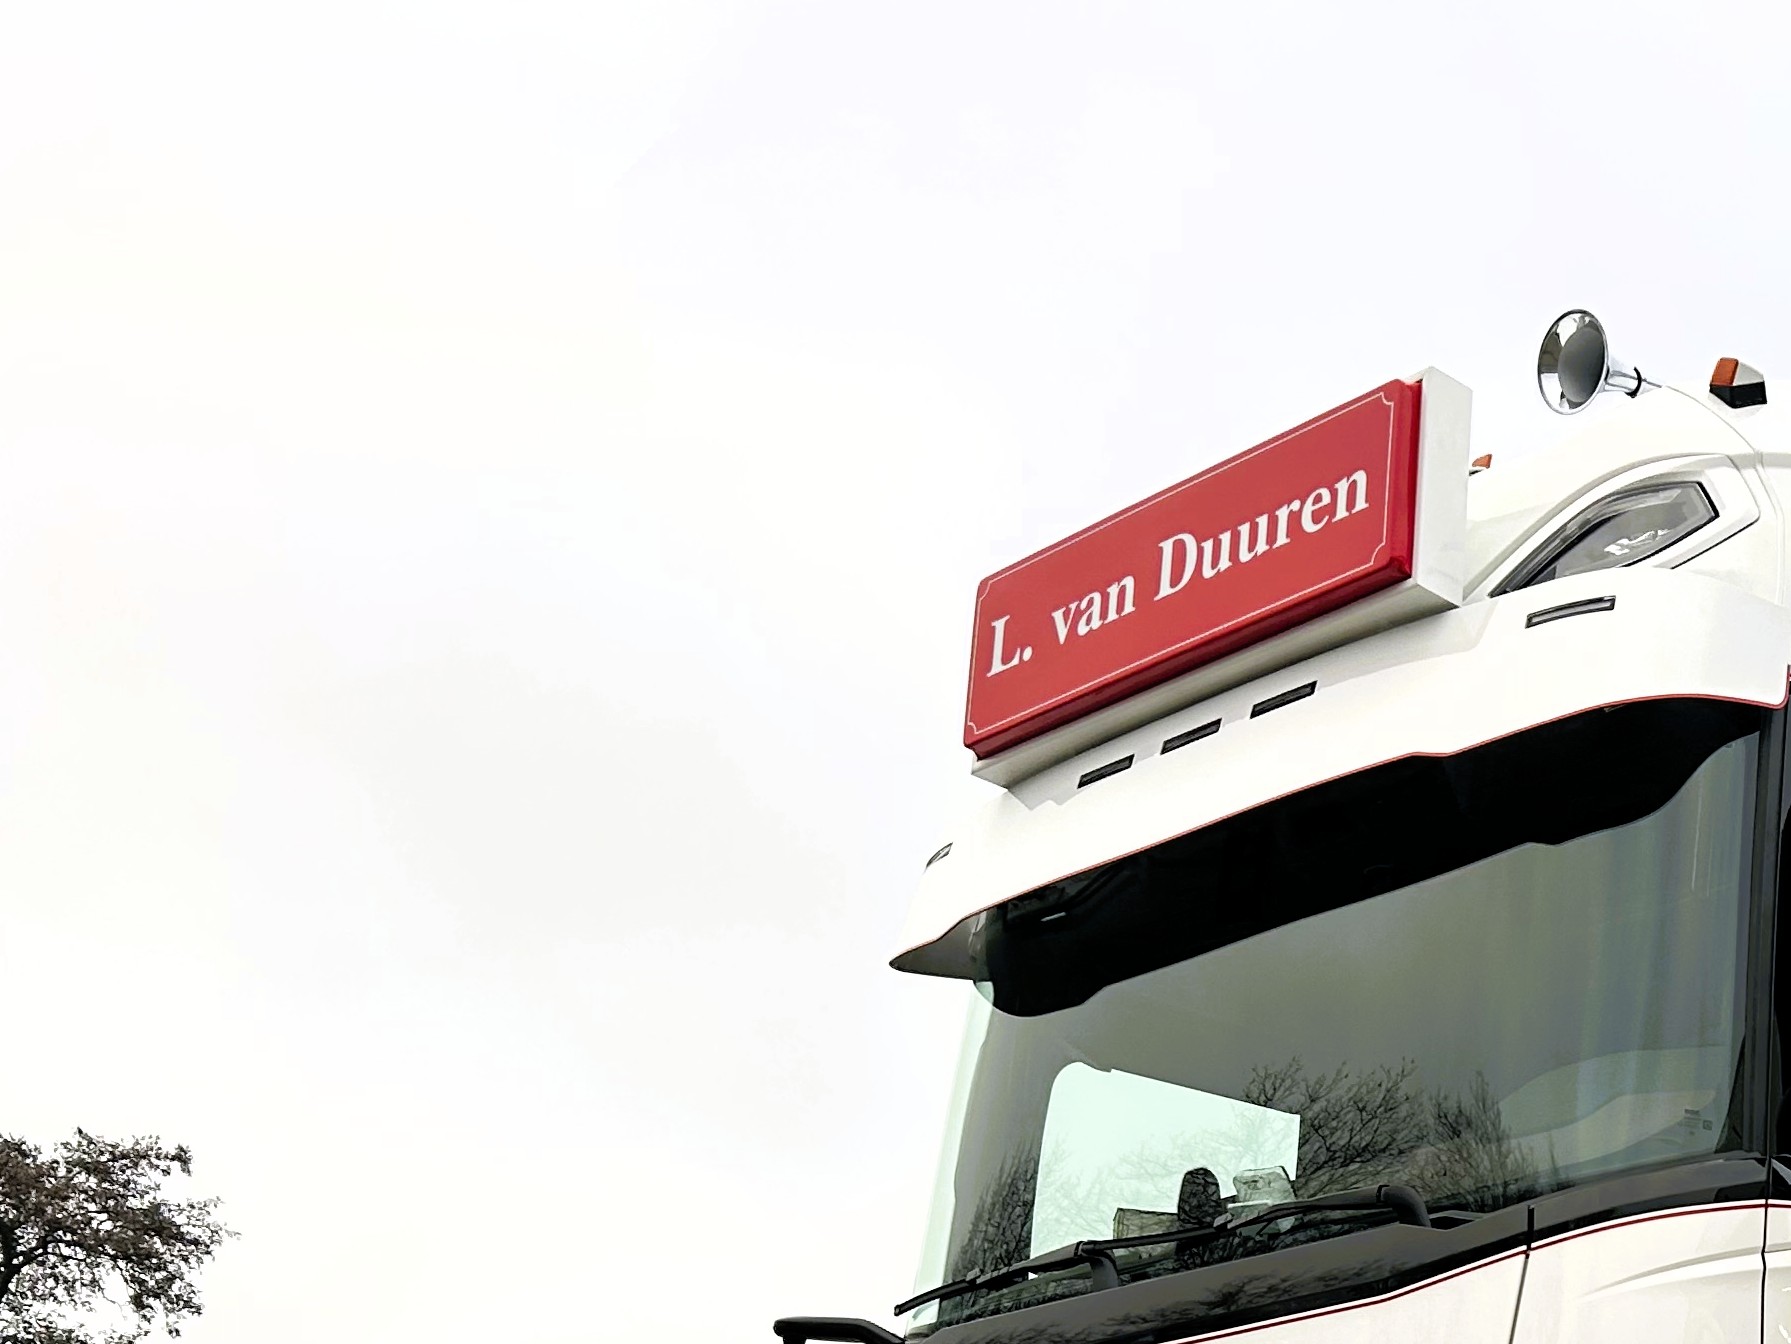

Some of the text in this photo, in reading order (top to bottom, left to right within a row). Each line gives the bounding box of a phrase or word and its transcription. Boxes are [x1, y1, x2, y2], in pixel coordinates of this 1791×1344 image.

[986, 468, 1370, 678] L. van Duuren
